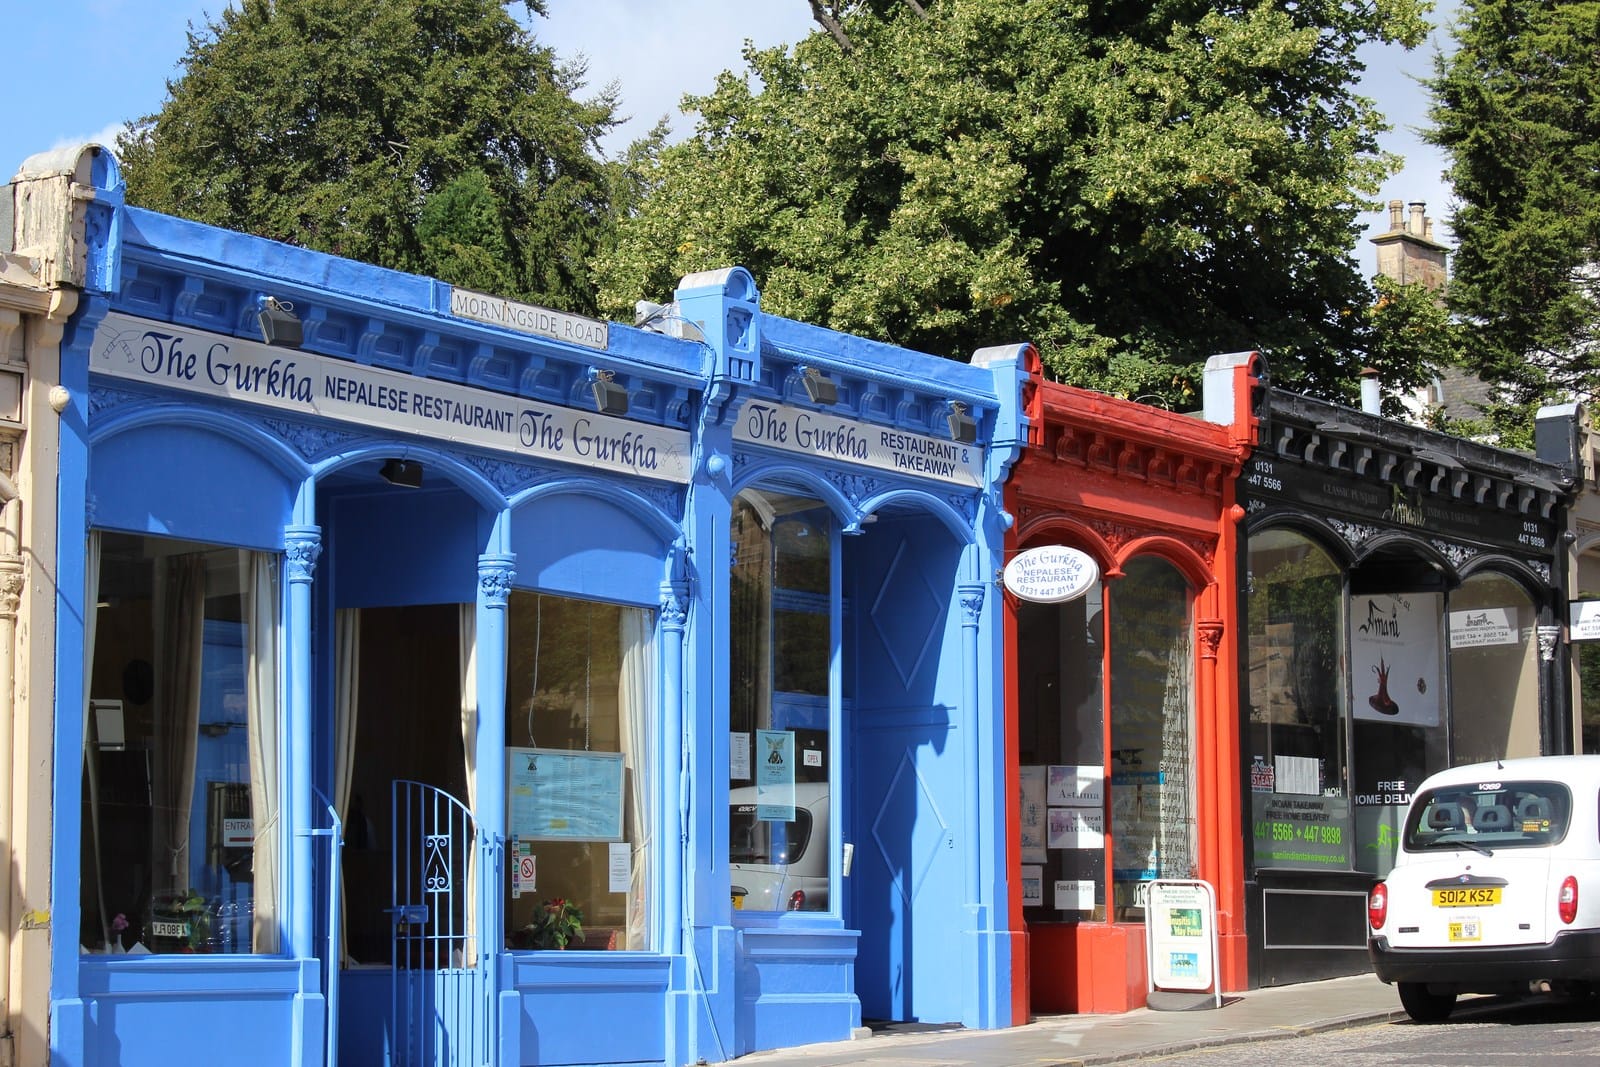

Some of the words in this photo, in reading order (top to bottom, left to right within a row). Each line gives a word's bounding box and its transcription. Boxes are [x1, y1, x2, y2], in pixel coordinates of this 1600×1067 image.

[455, 294, 557, 334] MORNINGSIDE
[565, 319, 604, 344] ROAD
[141, 331, 197, 381] The
[206, 343, 314, 403] Gurkha
[325, 375, 408, 414] NEPALESE
[412, 392, 515, 433] RESTAURANT
[748, 404, 788, 443] The
[795, 414, 869, 460] Gurkha
[519, 410, 564, 452] The
[573, 418, 658, 471] Gurkha
[880, 431, 959, 462] RESTAURANT
[961, 448, 970, 463] &
[892, 452, 956, 478] TAKEAWAY
[1255, 460, 1273, 474] 0131
[1263, 476, 1282, 491] 5566
[1523, 521, 1538, 534] 0131
[1518, 533, 1529, 545] 447
[1014, 556, 1037, 574] The
[1039, 550, 1084, 573] Gurkha
[1016, 574, 1079, 584] RESTAURANT
[1023, 567, 1073, 577] NEPALESE
[1019, 584, 1038, 596] 0131
[1040, 588, 1055, 596] 447
[1359, 599, 1401, 638] Amani
[1377, 781, 1406, 791] FREE
[1272, 799, 1292, 809] INDIAN
[1293, 800, 1325, 811] TAKEAWAY
[1384, 793, 1416, 804] DELIV
[225, 821, 254, 831] ENTRA
[1255, 821, 1270, 838] 447
[1272, 822, 1293, 841] 5566
[1304, 825, 1319, 842] 447
[1321, 827, 1342, 845] 9898
[1057, 883, 1070, 891] Food
[1469, 889, 1494, 902] KSZ
